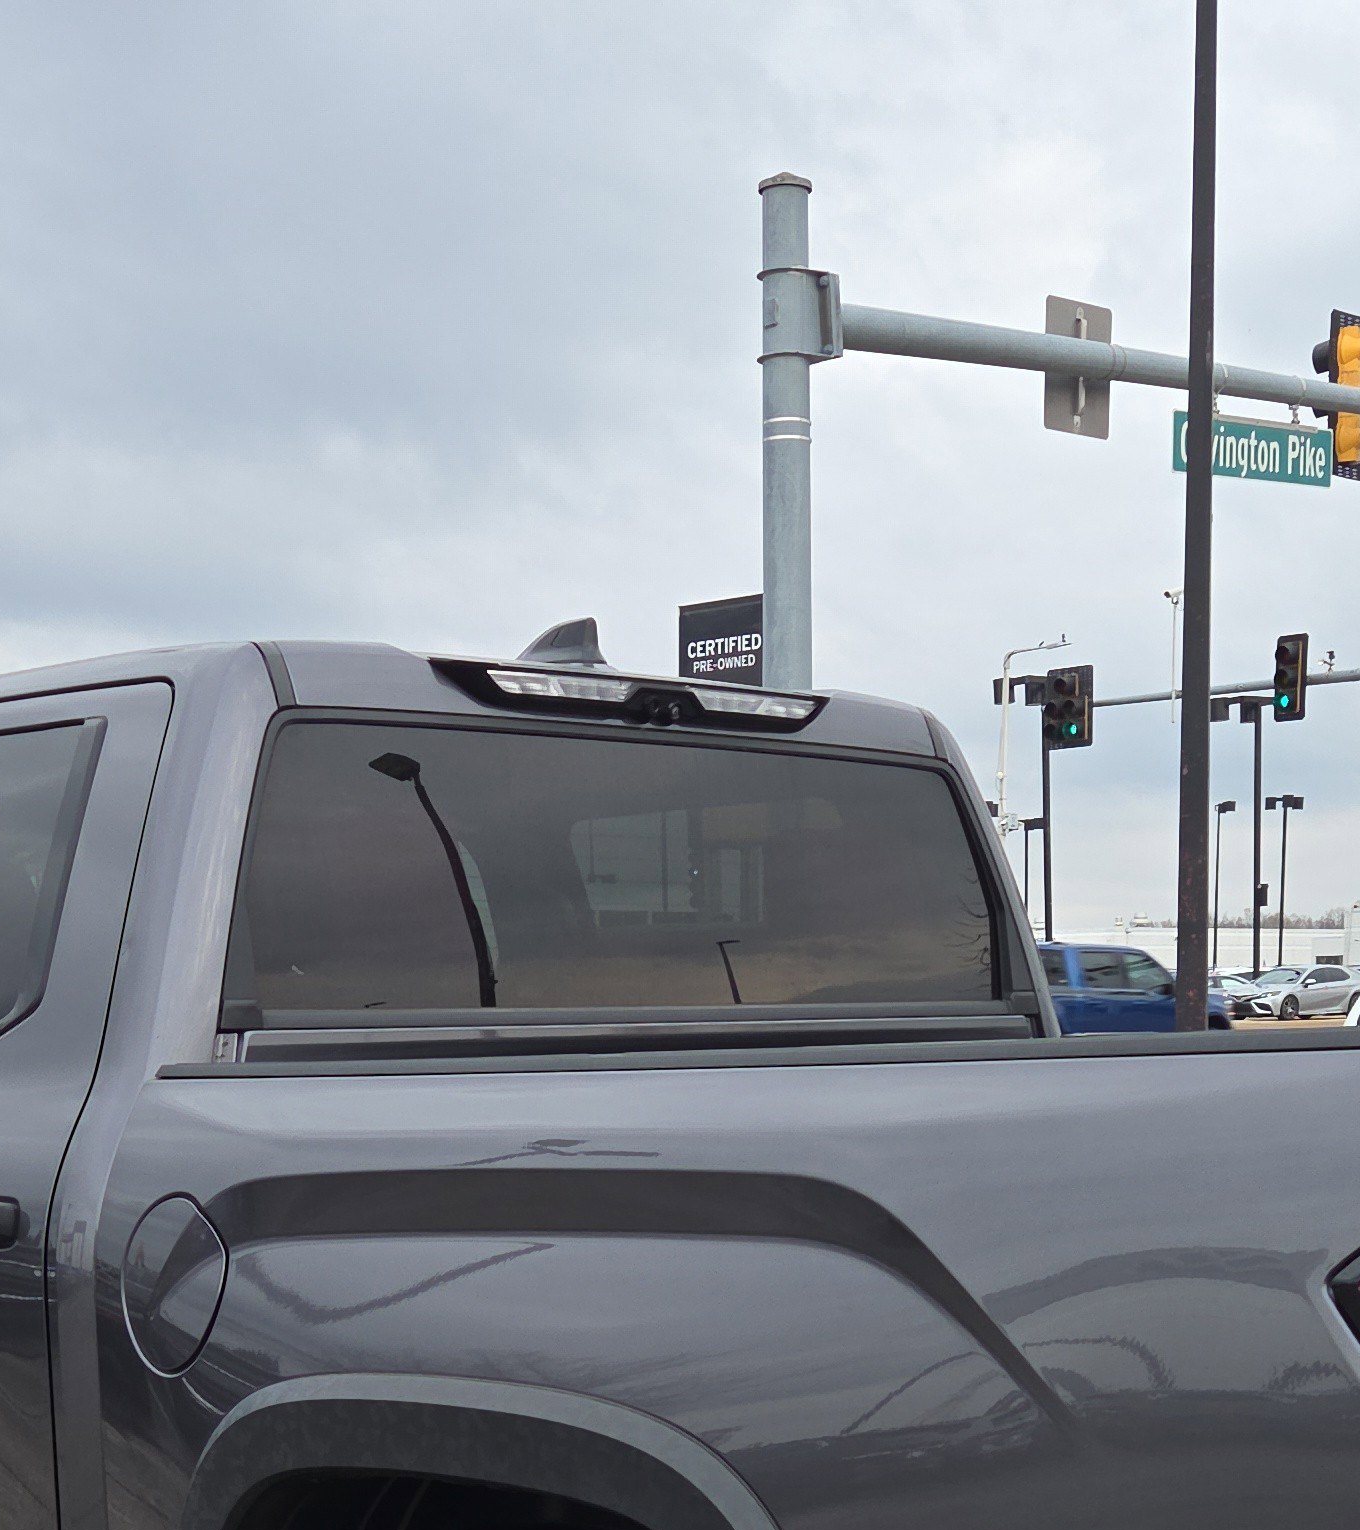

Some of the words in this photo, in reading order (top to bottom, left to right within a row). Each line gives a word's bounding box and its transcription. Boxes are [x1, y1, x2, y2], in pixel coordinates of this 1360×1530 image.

[1288, 434, 1326, 479] Pike
[687, 633, 762, 659] CERTIFIED
[693, 653, 756, 674] PRE-OWNED
